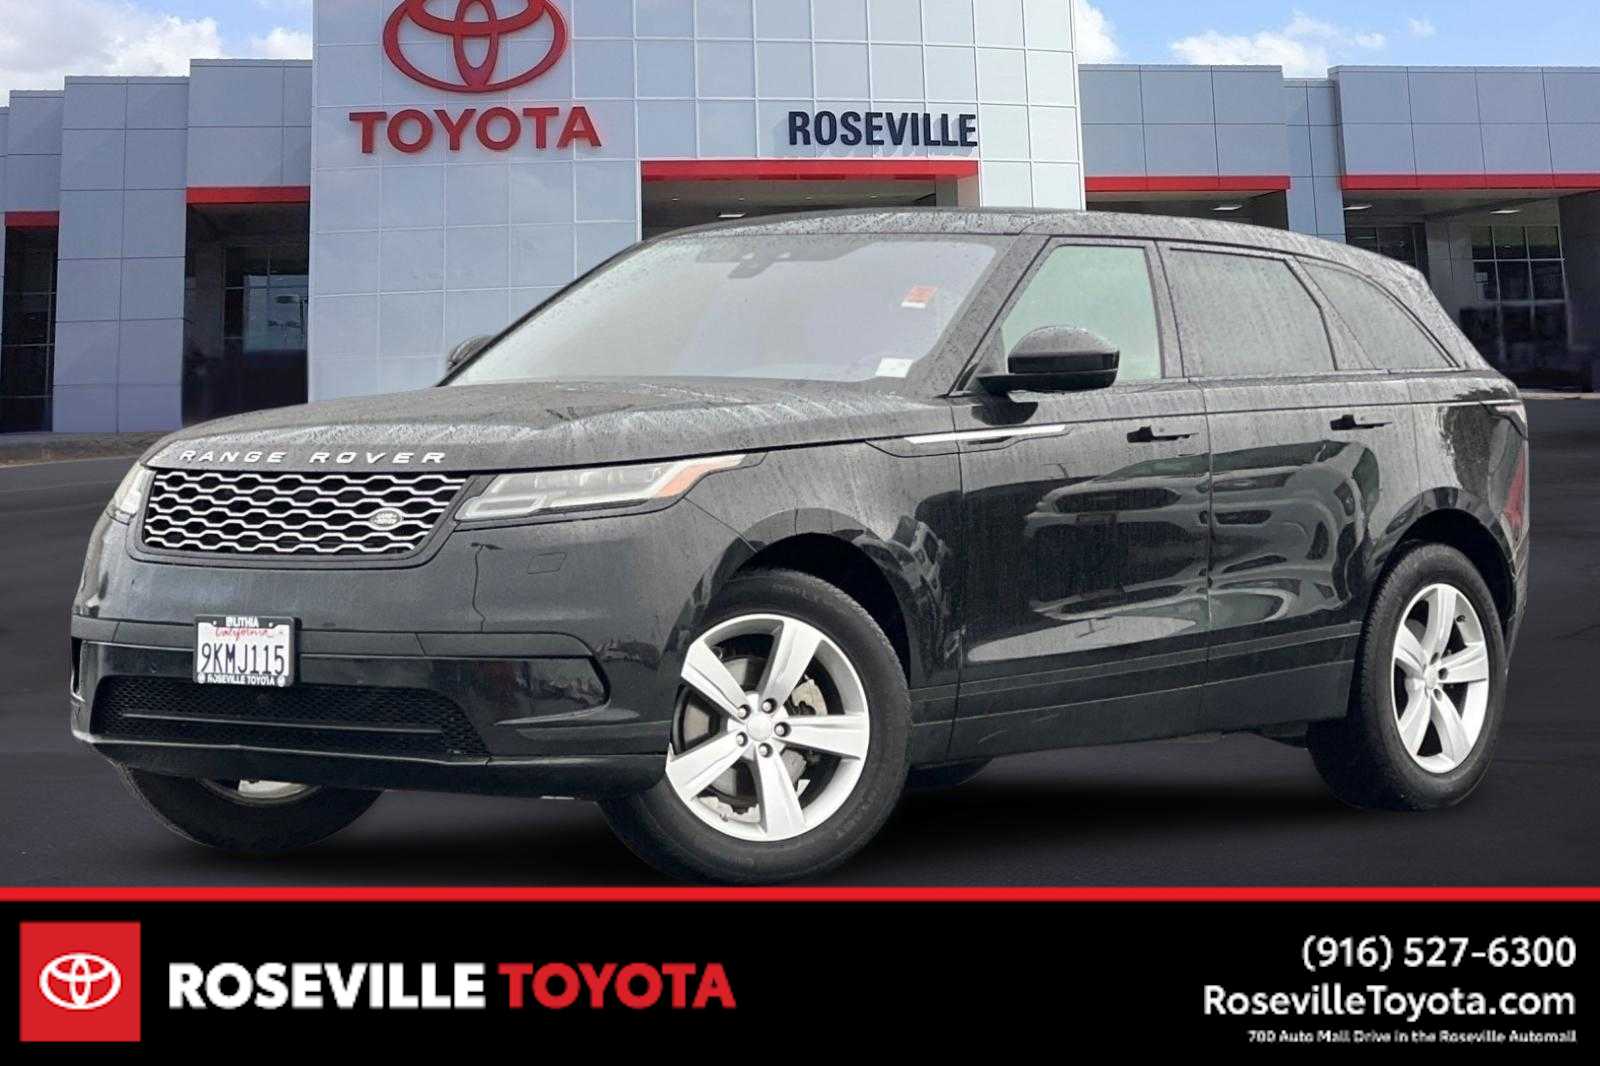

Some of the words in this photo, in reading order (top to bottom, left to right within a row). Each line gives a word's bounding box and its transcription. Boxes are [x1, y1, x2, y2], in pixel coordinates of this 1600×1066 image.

[349, 106, 602, 154] TOYOTA
[788, 111, 978, 147] ROSEVILLE
[178, 450, 288, 463] RANGE
[309, 451, 446, 464] ROVER
[201, 643, 285, 675] 9KMJ115
[207, 673, 246, 685] ROSEVILLE
[247, 675, 275, 686] TOYOTA
